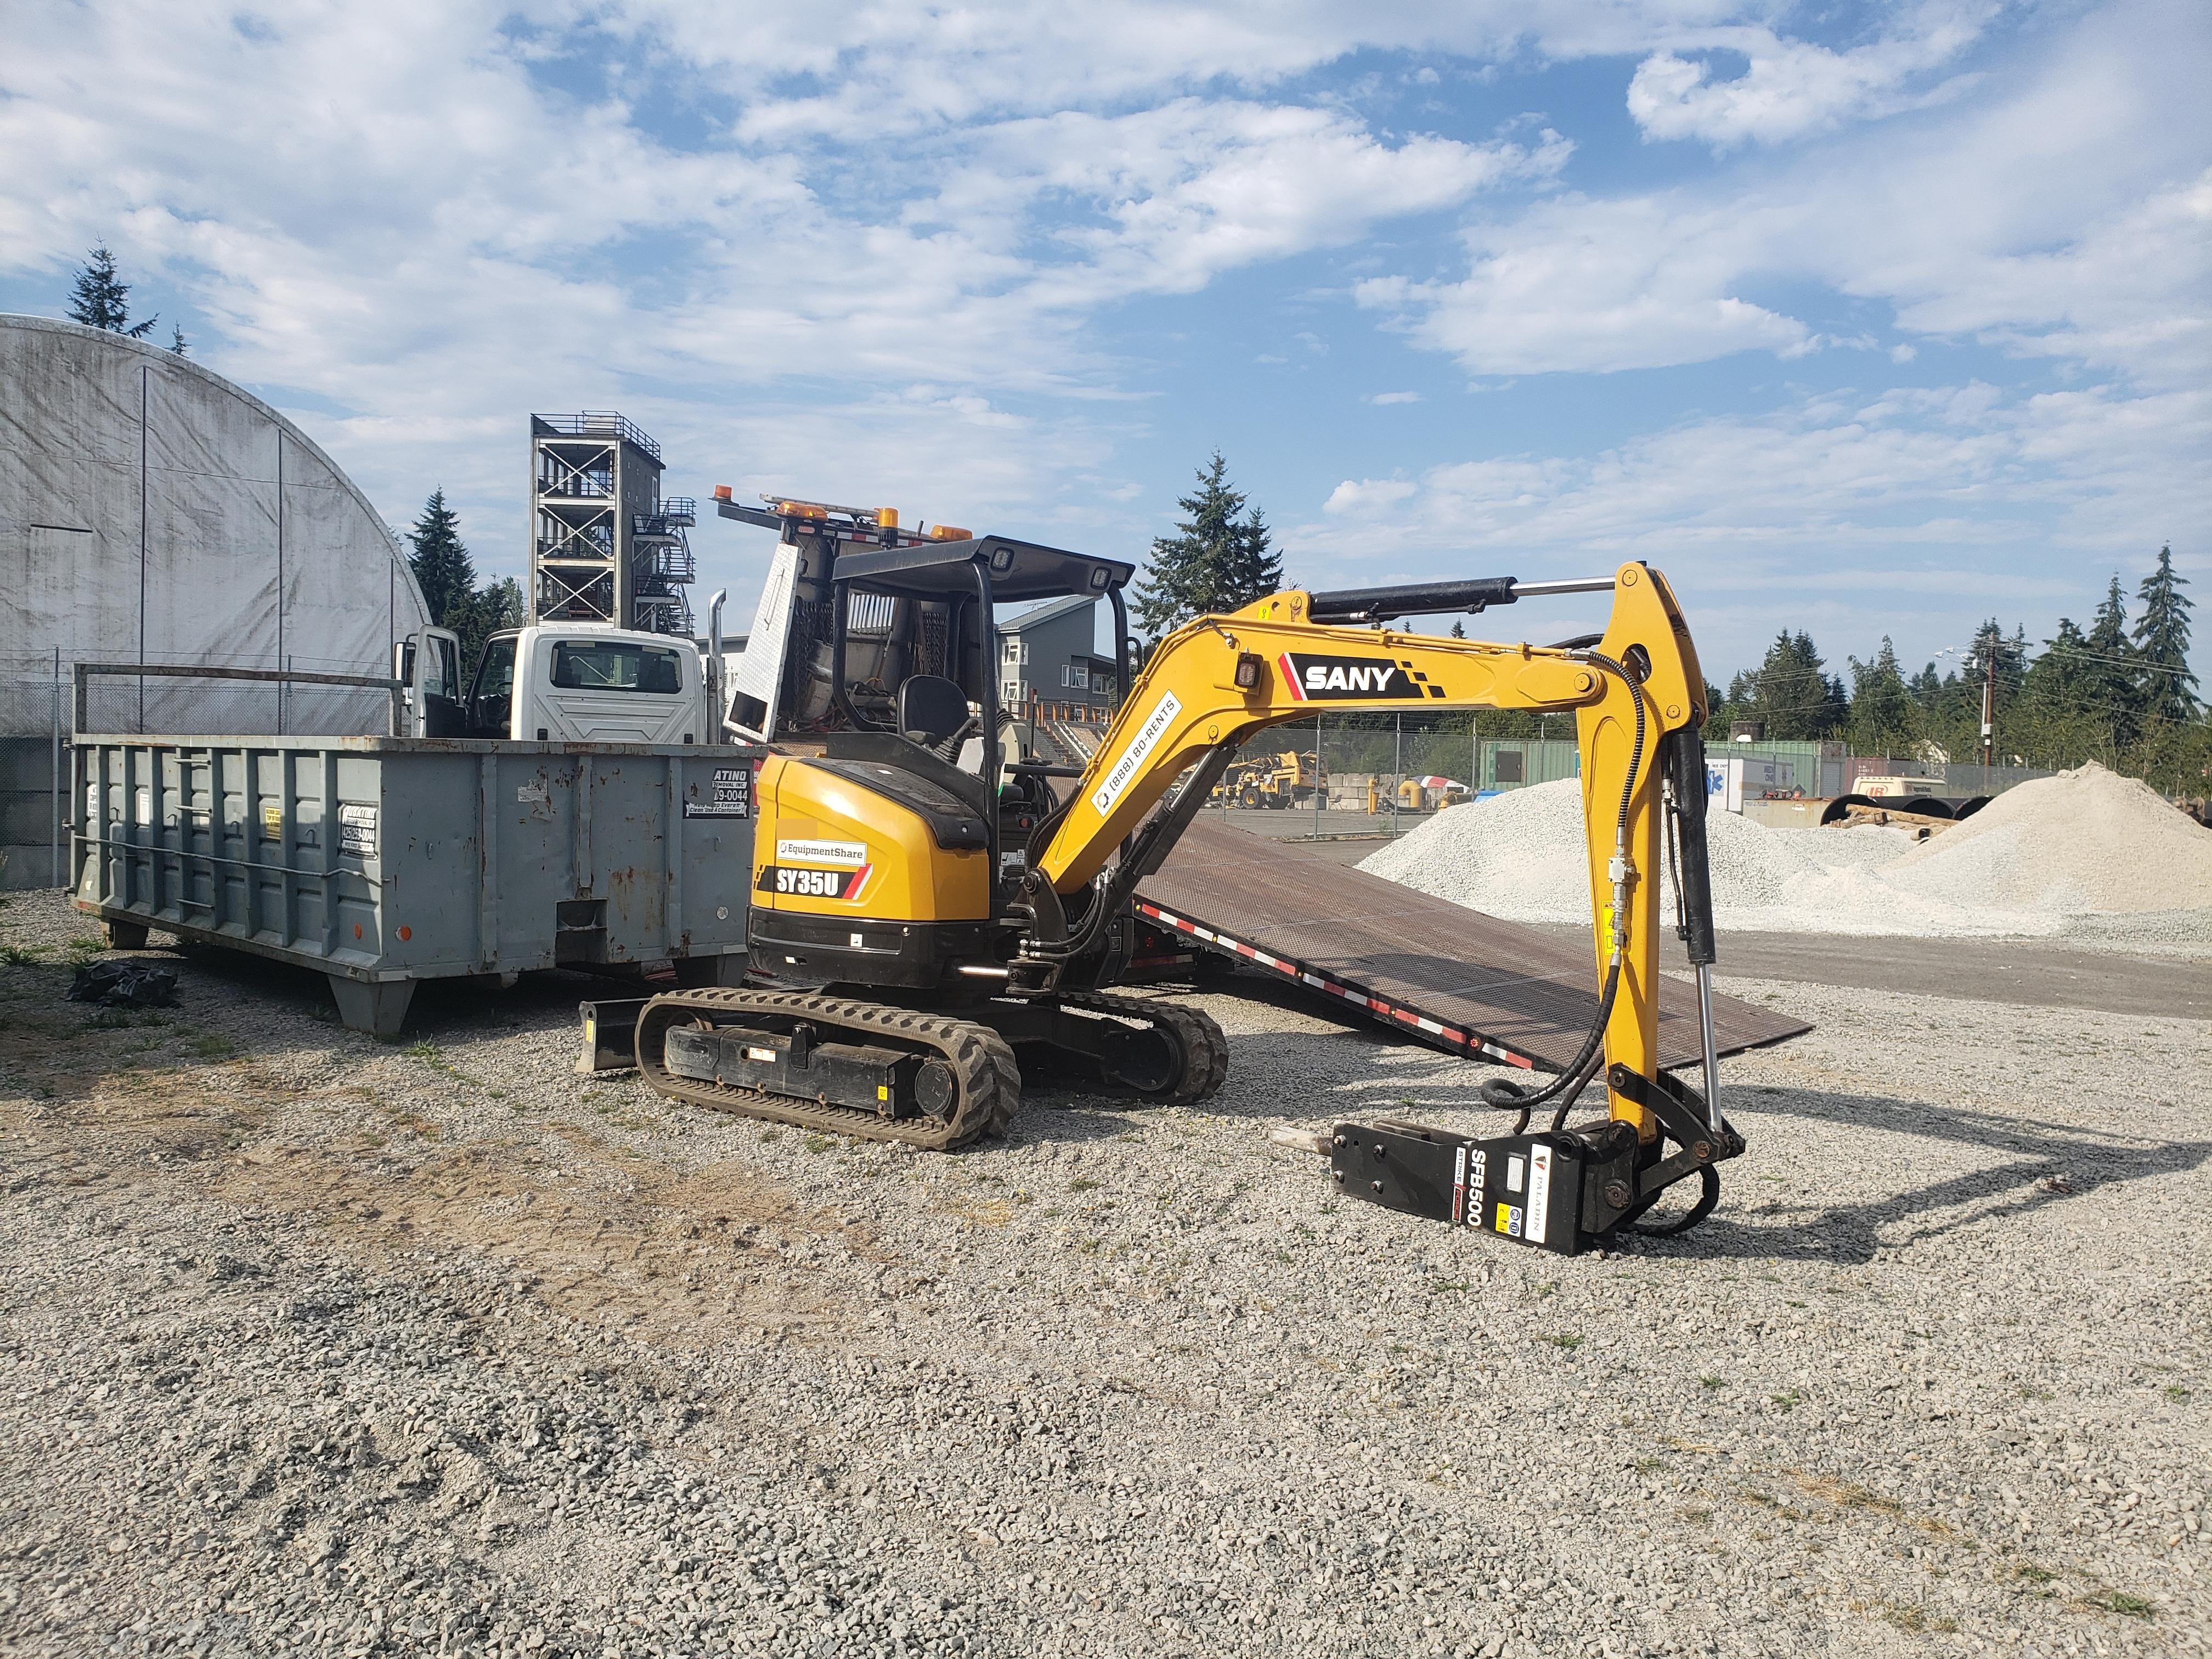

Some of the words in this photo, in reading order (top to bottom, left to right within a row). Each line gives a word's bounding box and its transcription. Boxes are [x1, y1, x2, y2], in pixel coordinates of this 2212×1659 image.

[1306, 666, 1396, 691] SANY
[1109, 757, 1134, 791] (888)
[1133, 700, 1175, 758] 80-RENTS
[788, 844, 863, 859] EquipmentShare
[777, 869, 839, 896] SY35U
[1467, 1149, 1486, 1226] SFB500
[1534, 1176, 1543, 1231] PALADIN
